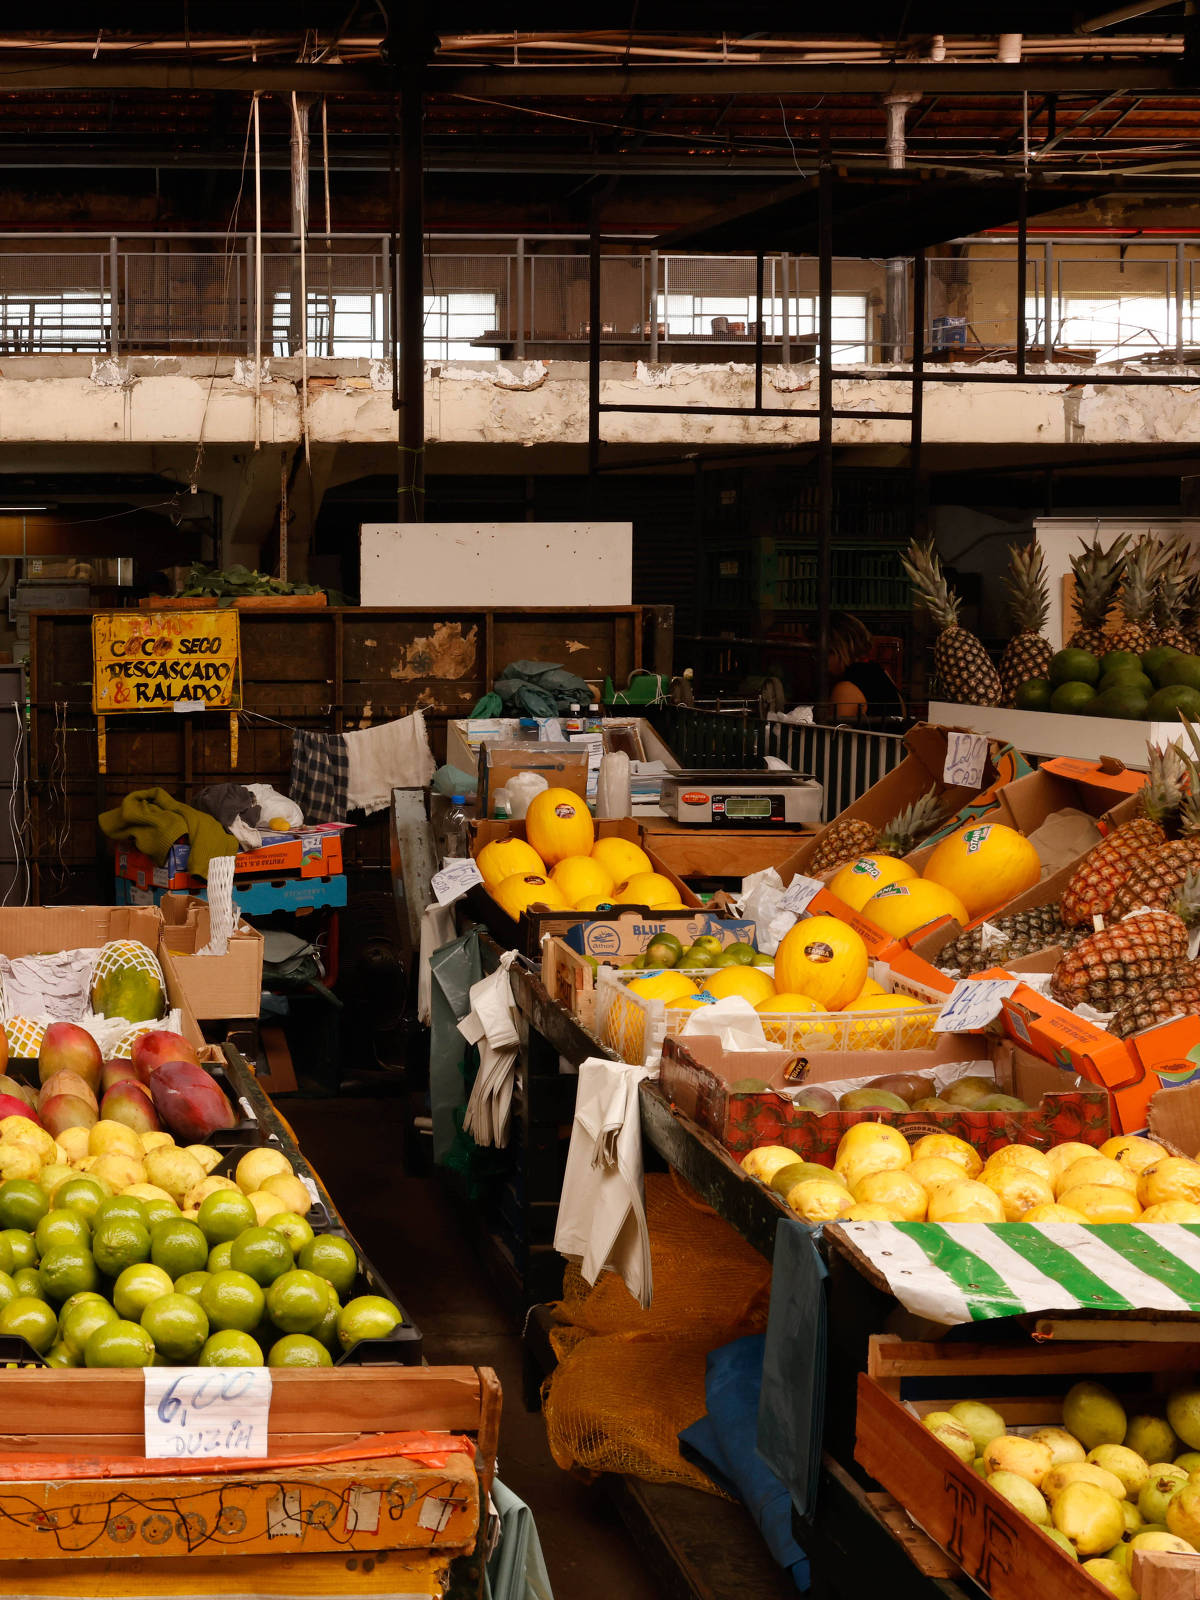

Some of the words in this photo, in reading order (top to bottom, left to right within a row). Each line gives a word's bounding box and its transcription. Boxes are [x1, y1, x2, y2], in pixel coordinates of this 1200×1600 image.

[178, 636, 222, 655] SECO
[104, 660, 231, 681] DESCASCADO
[632, 924, 667, 936] BLUE
[157, 1371, 256, 1428] 6,00
